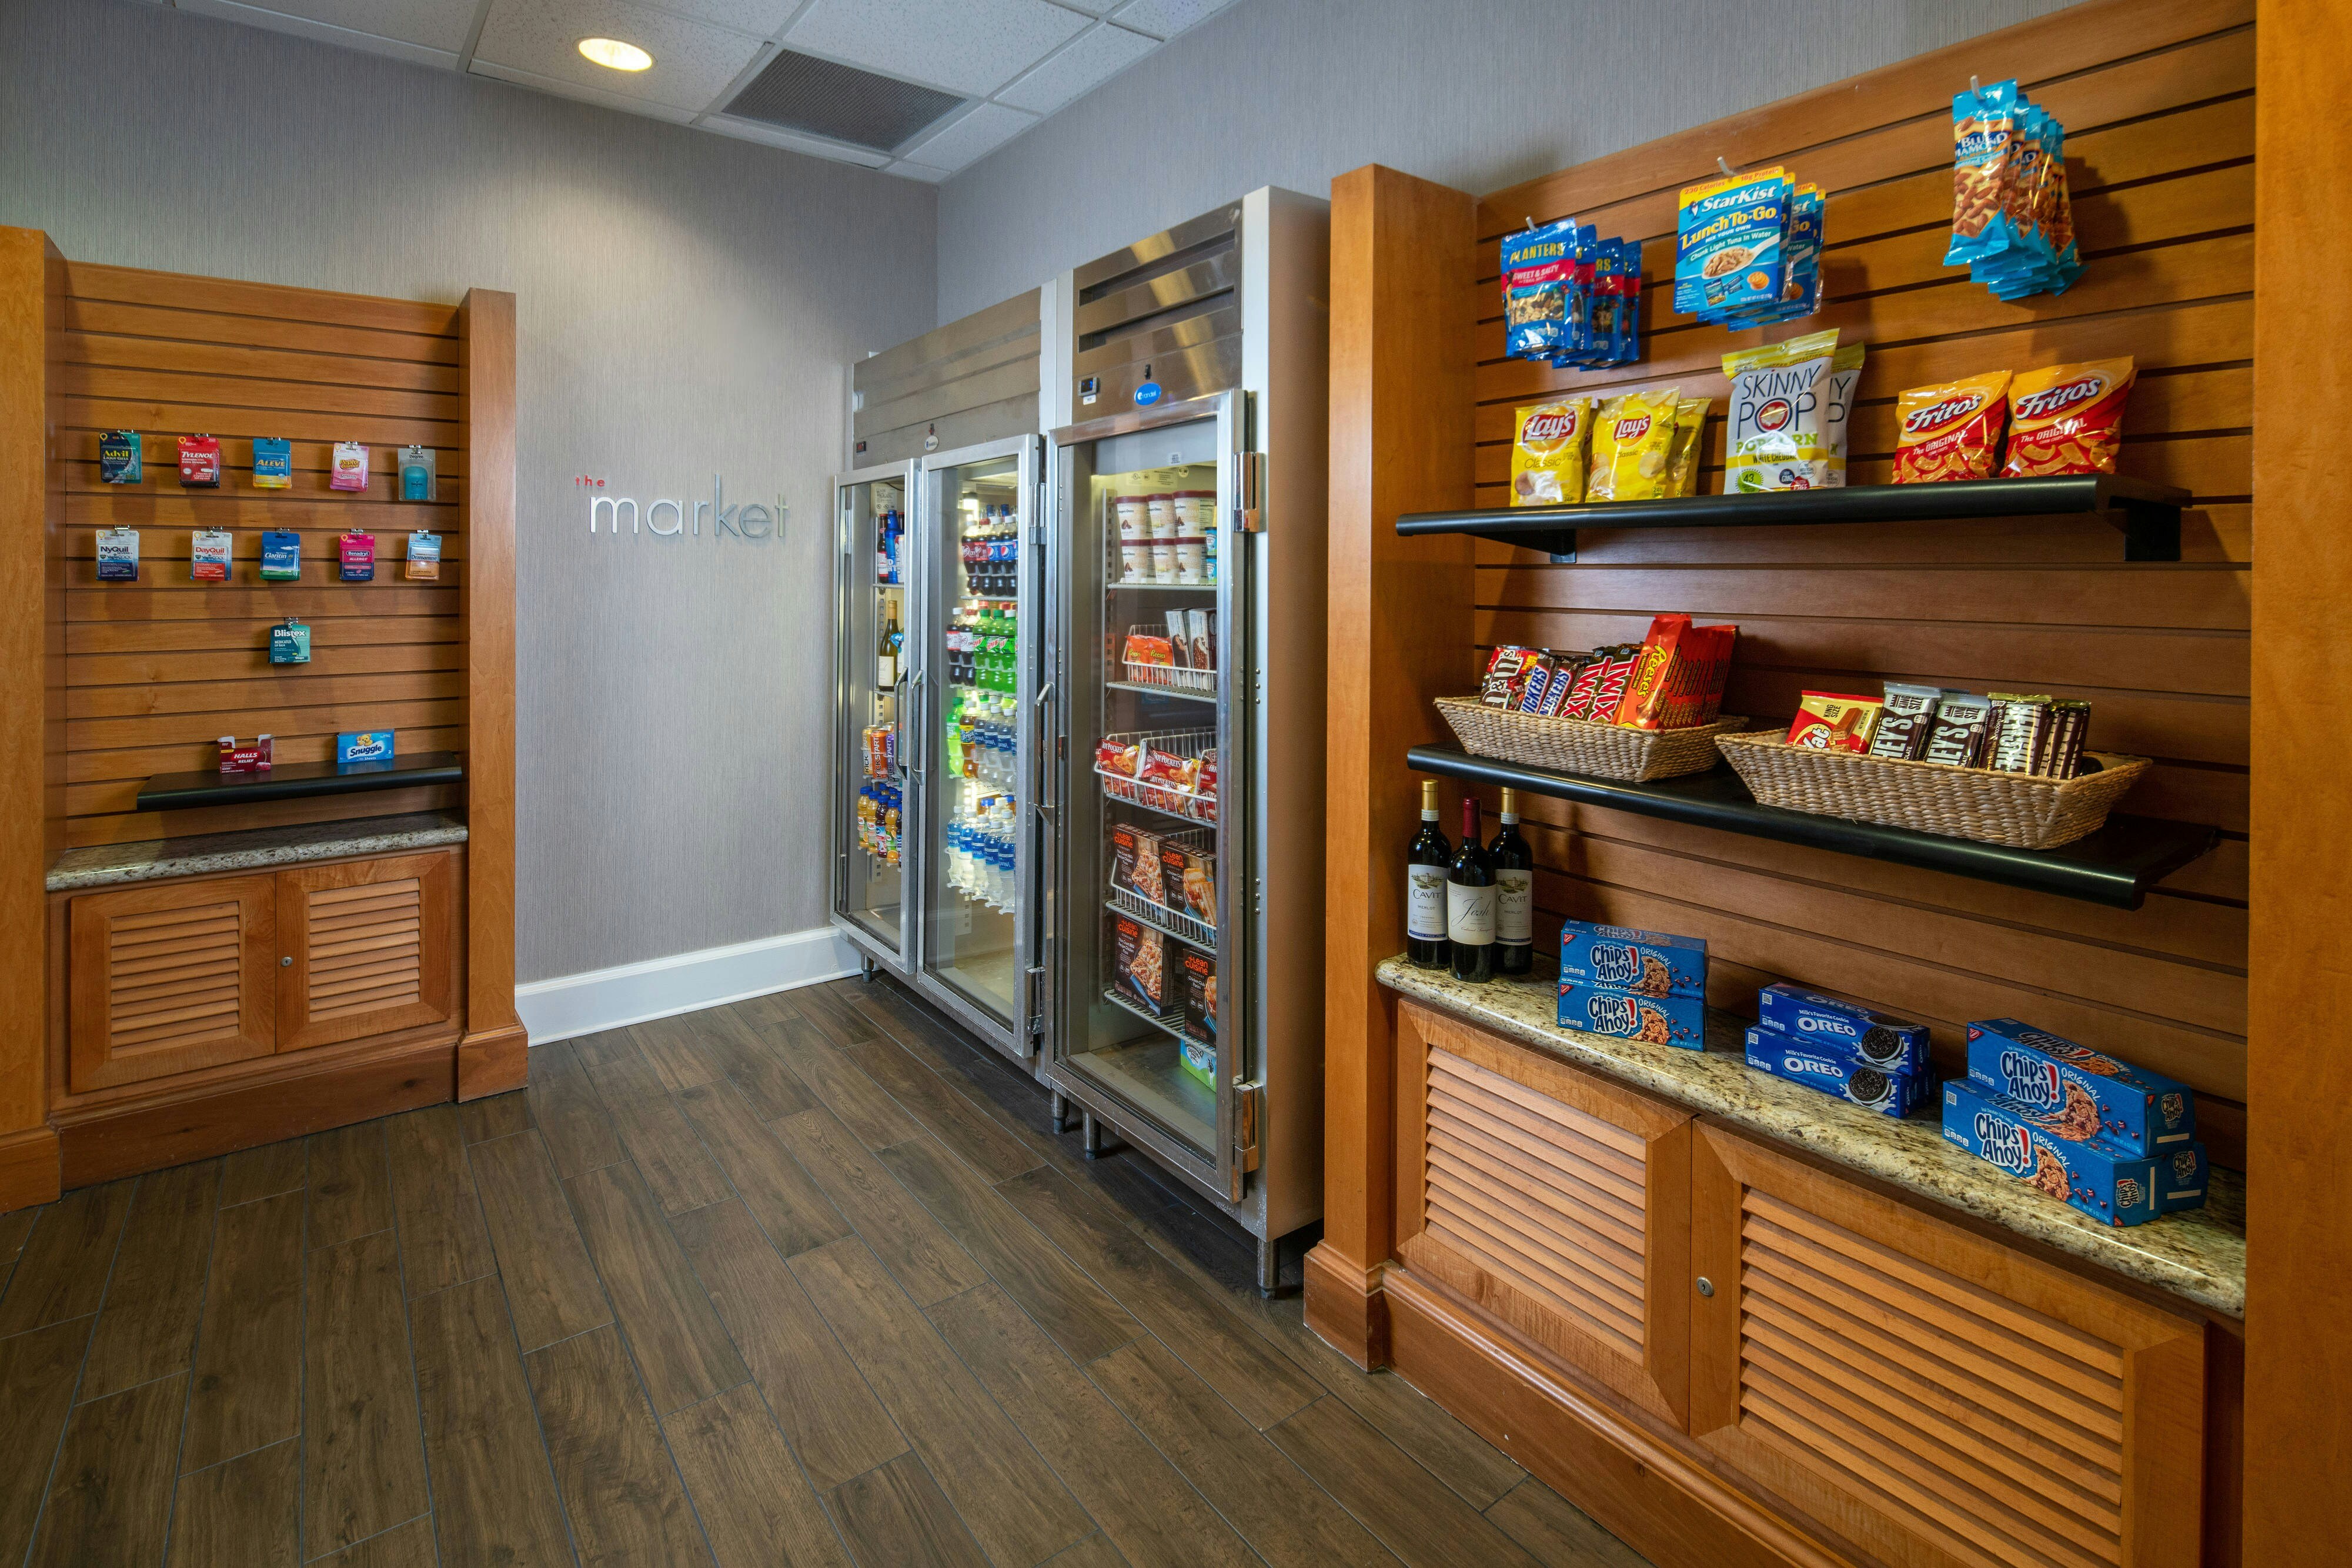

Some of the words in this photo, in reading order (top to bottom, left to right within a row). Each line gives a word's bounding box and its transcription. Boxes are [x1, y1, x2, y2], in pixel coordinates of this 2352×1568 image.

[1702, 185, 1778, 212] StarKist
[1680, 216, 1729, 250] Lunch
[1718, 229, 1735, 238] YOUR
[1735, 224, 1751, 232] OWN
[1509, 242, 1565, 265] PLANTERS
[1690, 248, 1709, 261] Chunk
[1710, 241, 1726, 253] Light
[1727, 236, 1742, 246] Tuna
[1751, 230, 1771, 240] Water
[1513, 270, 1535, 280] SWEET
[1541, 264, 1559, 276] SALTY
[1742, 365, 1822, 400] SKINNY
[2016, 378, 2102, 420] Fritos
[1737, 392, 1817, 440] POP
[1906, 394, 1983, 433] Fritos
[1524, 413, 1576, 442] Lay's
[1615, 414, 1651, 440] Lay's
[1913, 447, 1924, 456] The
[1926, 429, 1968, 452] ORIGINAL
[2021, 434, 2034, 443] The
[256, 459, 286, 467] ALEVE
[1524, 457, 1562, 469] Classic
[574, 474, 606, 487] the
[1743, 473, 1755, 483] 43
[590, 473, 789, 539] market
[274, 629, 306, 638] Blistex
[1150, 649, 1166, 658] Reese's
[1637, 644, 1668, 698] Reese's
[1561, 656, 1613, 718] TWIX
[1588, 654, 1641, 722] TWIX
[1823, 704, 1834, 718] KING
[1831, 706, 1841, 718] SIZE
[1898, 695, 1912, 709] KING
[1909, 697, 1924, 710] SIZE
[1953, 706, 1969, 718] KING
[1964, 707, 1981, 720] SIZE
[349, 744, 383, 758] Snuggle
[873, 737, 881, 778] KICKSTART
[1161, 755, 1181, 768] POCKETS
[1413, 888, 1441, 900] CAVIT
[1498, 894, 1528, 904] CAVIT
[1451, 896, 1491, 927] Josh
[1594, 926, 1632, 935] Chips
[1591, 945, 1630, 968] Chips
[1640, 947, 1672, 967] ORIGINAL
[1596, 961, 1638, 982] Ahoy!
[1588, 996, 1628, 1019] Chips
[1638, 998, 1670, 1019] ORIGINAL
[1813, 1011, 1833, 1019] Favorite
[1833, 1015, 1849, 1024] Cookie
[1593, 1013, 1638, 1035] Ahoy!
[1798, 1017, 1857, 1037] OREO
[2019, 1032, 2078, 1052] Chips
[1783, 1057, 1844, 1078] OREO
[1800, 1052, 1820, 1061] Favorite
[1820, 1056, 1837, 1065] Cookie
[2001, 1051, 2048, 1082] Chips
[2008, 1076, 2058, 1109] Ahoy!
[2061, 1068, 2102, 1102] ORIGINAL
[2161, 1096, 2178, 1114] Chips
[1975, 1113, 2020, 1146] Chips
[1982, 1139, 2031, 1172] Ahoy!
[2032, 1132, 2070, 1169] ORIGINAL
